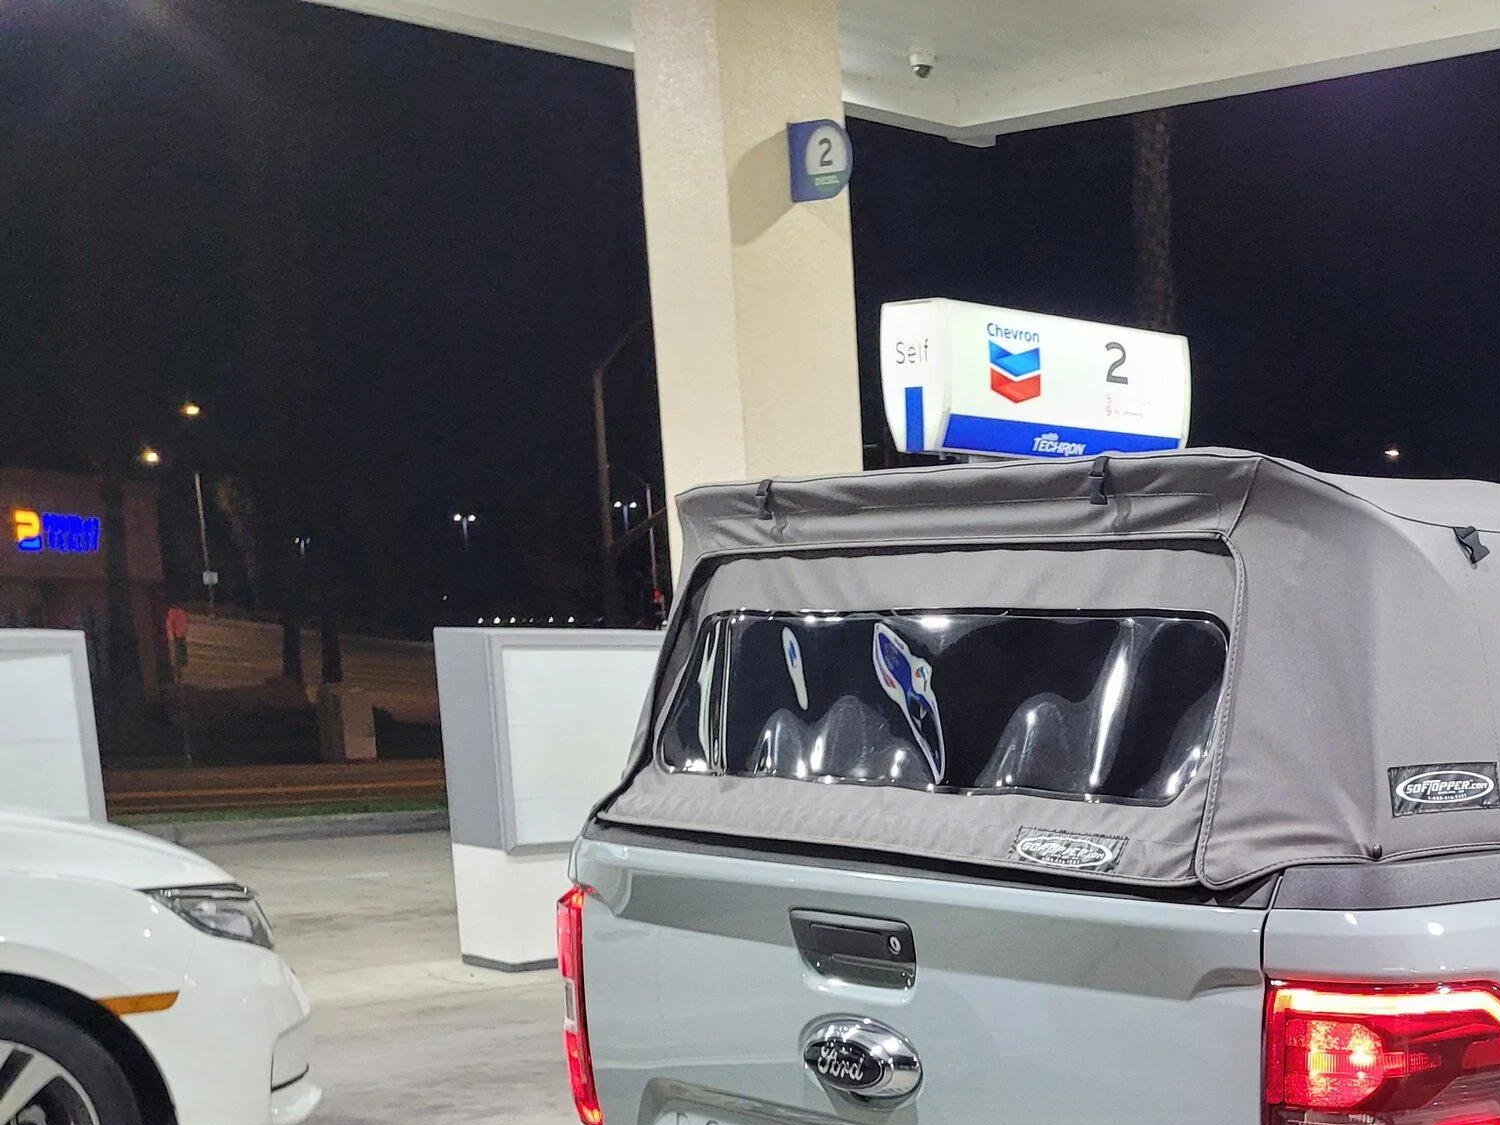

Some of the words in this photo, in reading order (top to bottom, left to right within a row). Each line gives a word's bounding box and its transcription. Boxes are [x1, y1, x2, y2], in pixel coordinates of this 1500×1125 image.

[818, 137, 833, 167] 2
[986, 322, 1041, 344] Chevron
[895, 338, 929, 365] Self
[1104, 341, 1129, 385] 2
[1032, 437, 1087, 457] TECHRON
